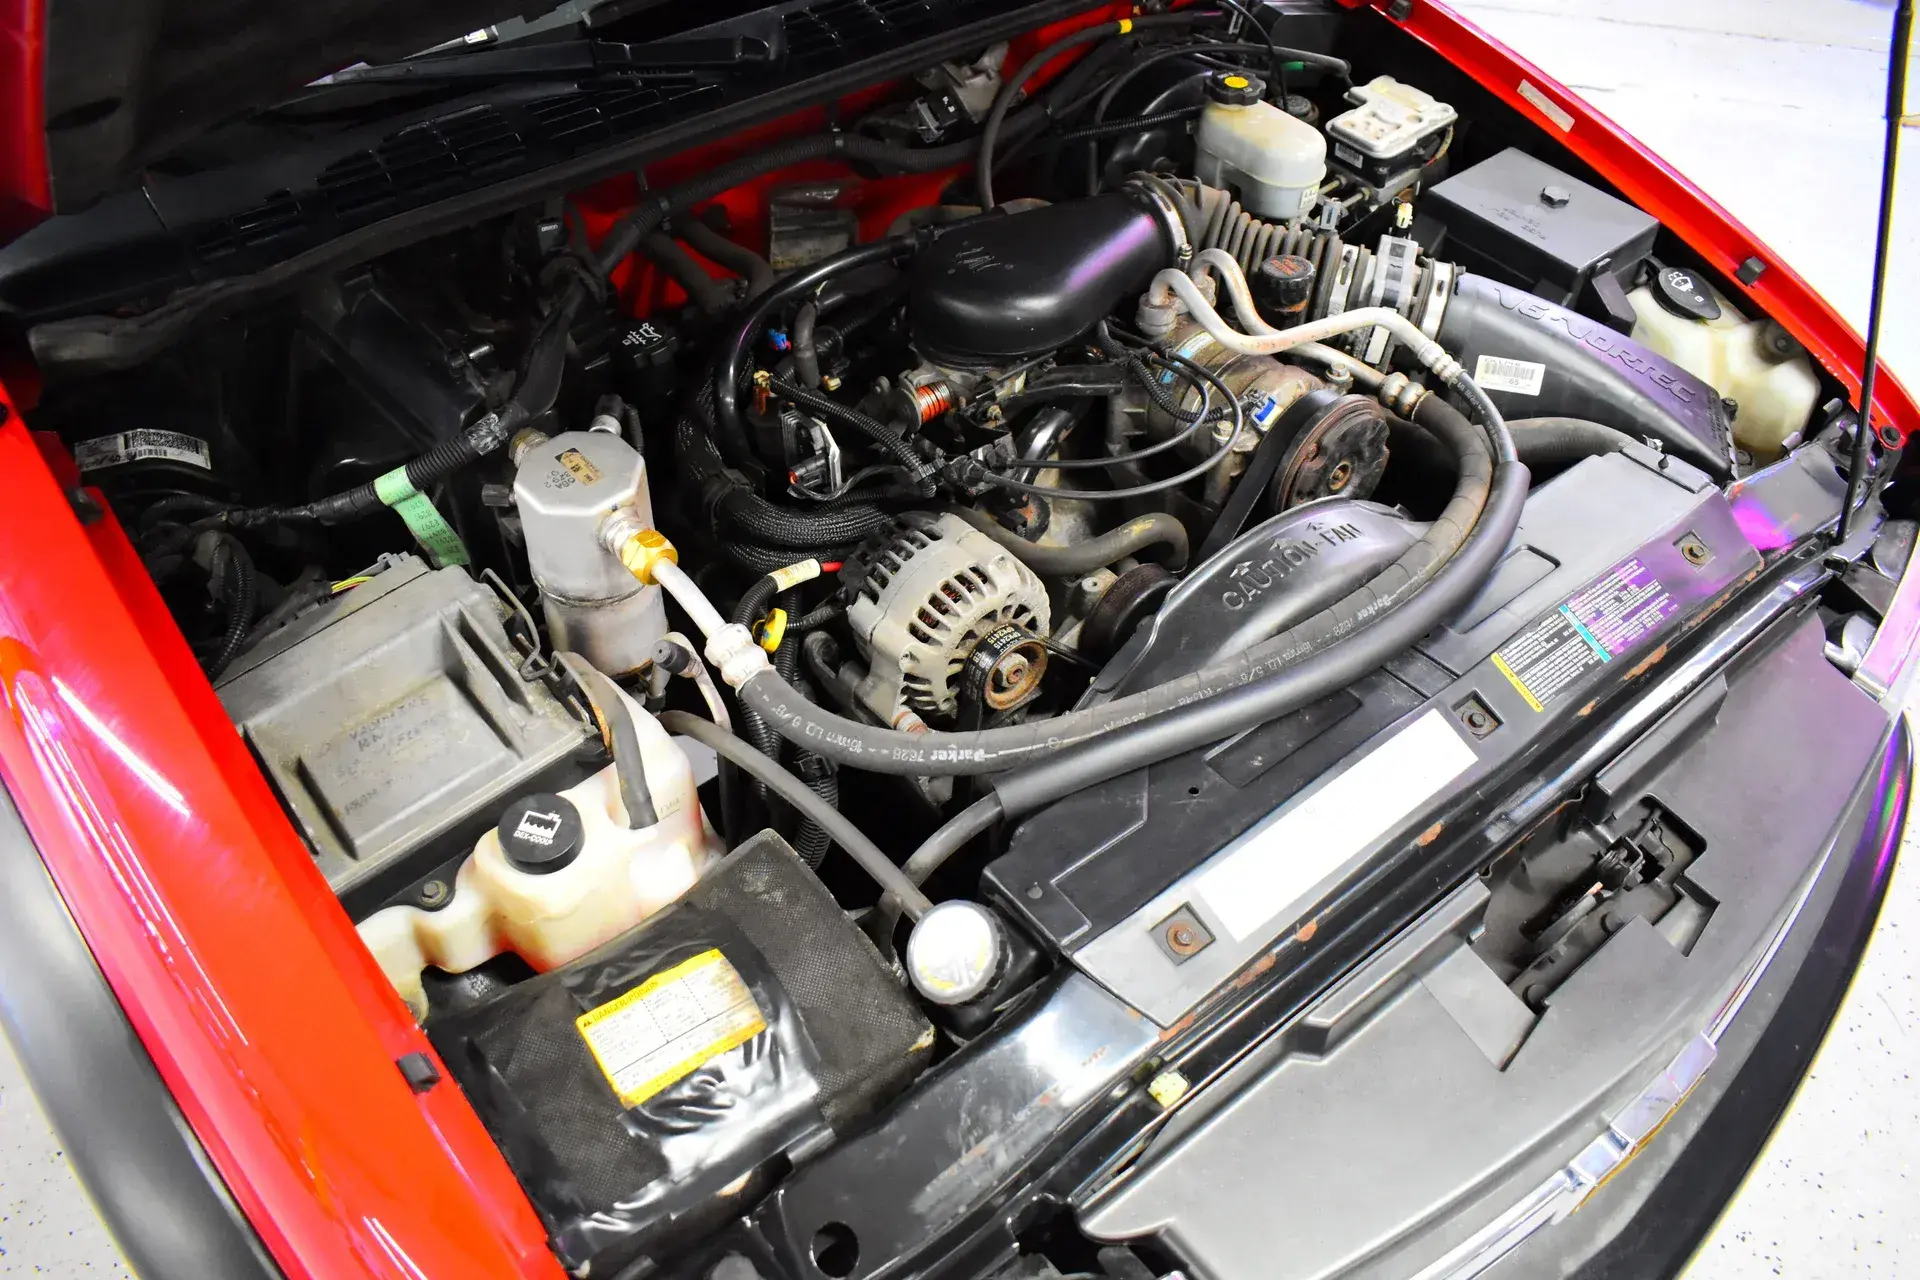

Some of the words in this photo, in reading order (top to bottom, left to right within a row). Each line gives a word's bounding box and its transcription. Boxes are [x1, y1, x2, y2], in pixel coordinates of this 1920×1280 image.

[1552, 316, 1696, 403] VORTEC
[892, 748, 925, 761] 7628
[930, 743, 986, 764] Parker
